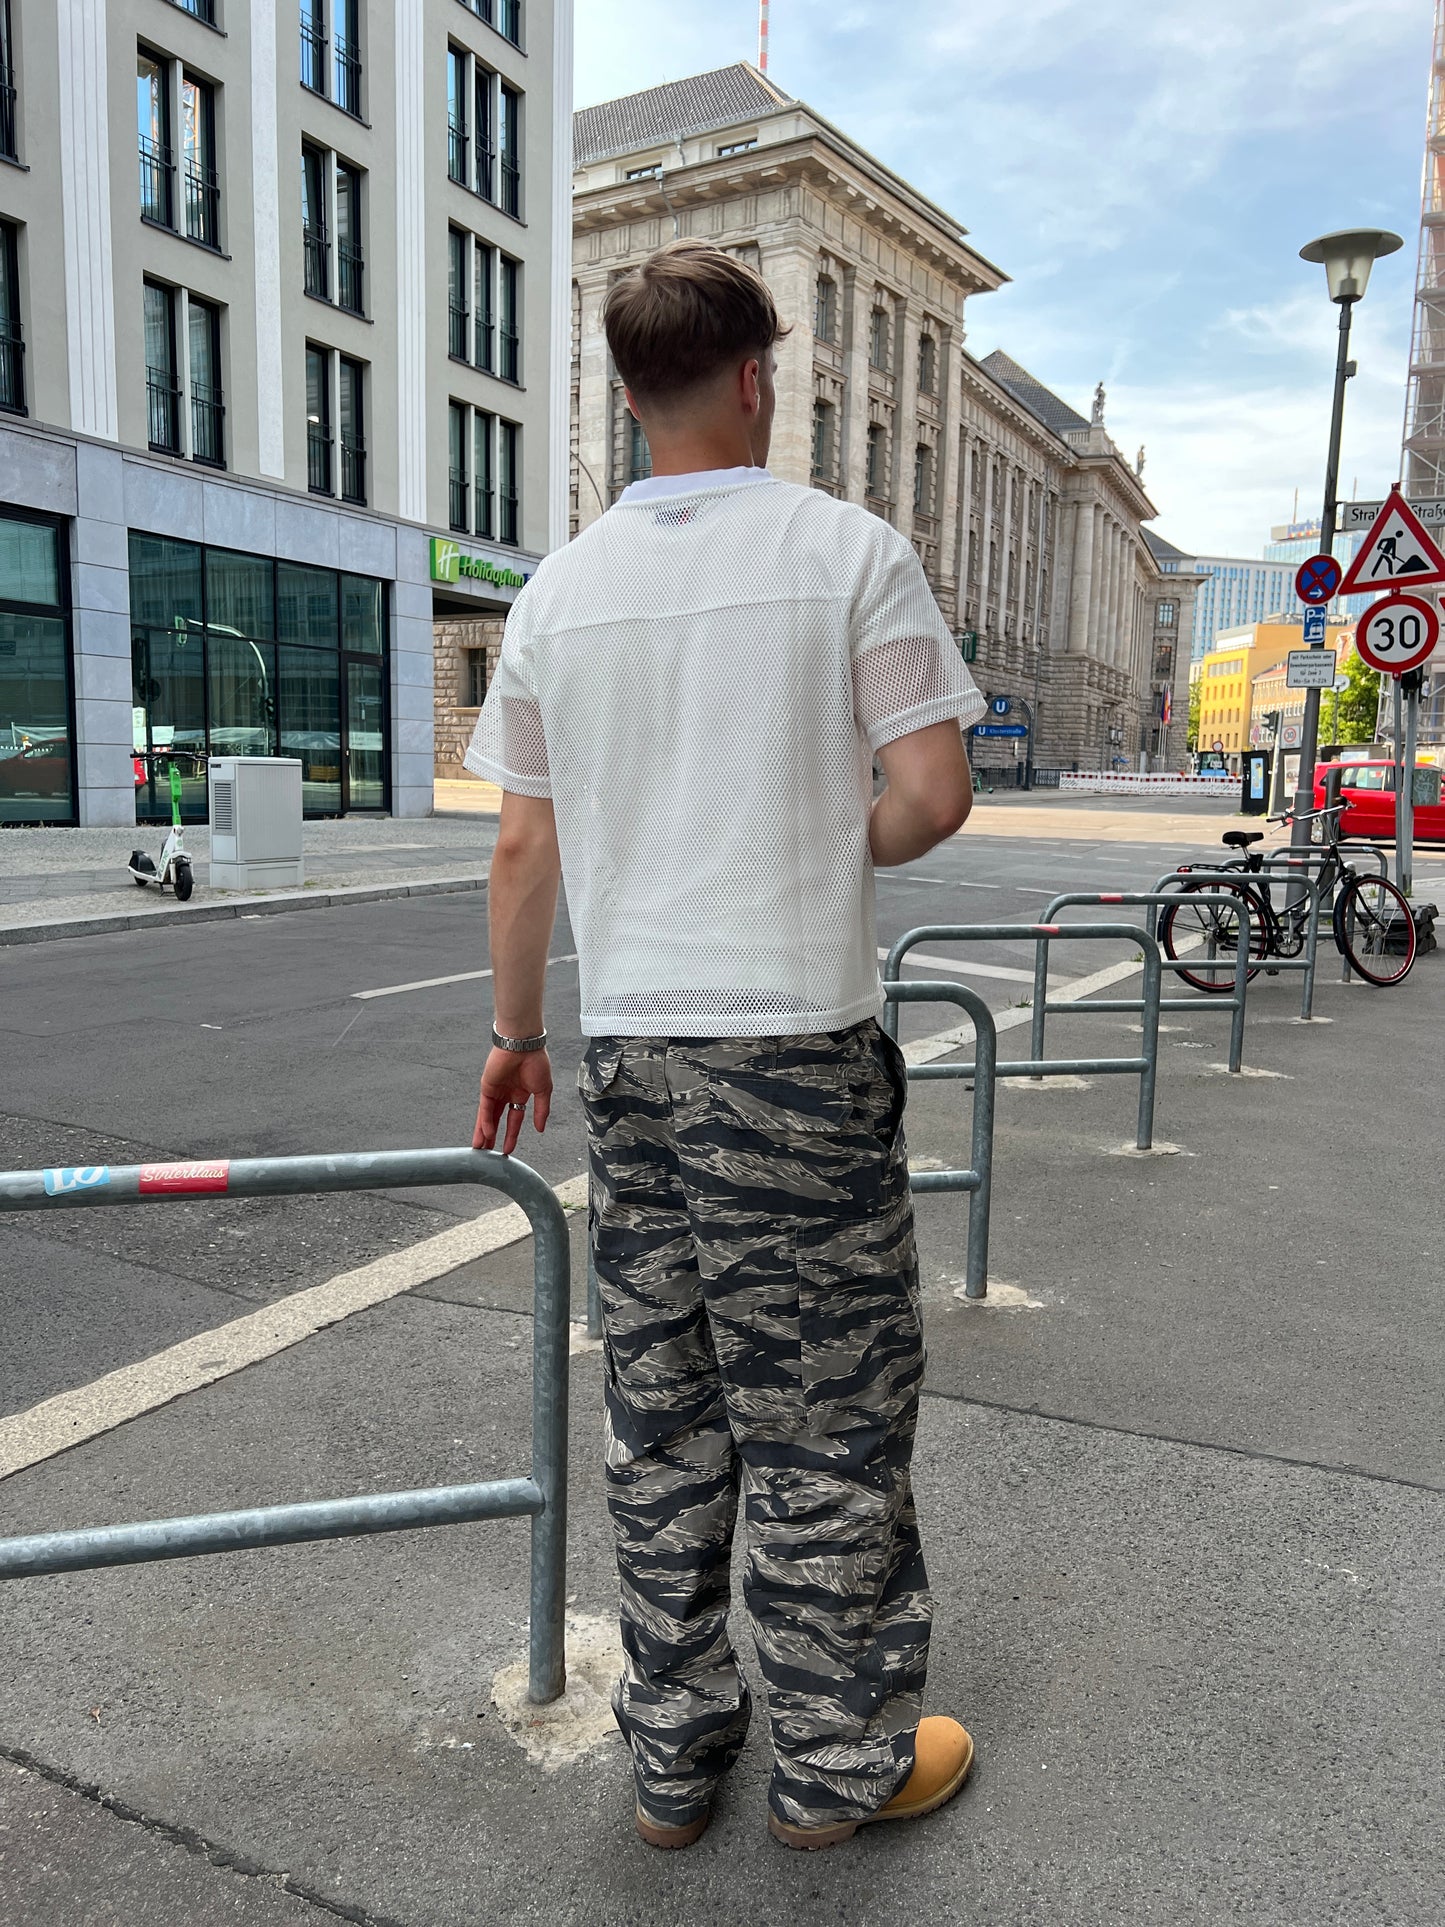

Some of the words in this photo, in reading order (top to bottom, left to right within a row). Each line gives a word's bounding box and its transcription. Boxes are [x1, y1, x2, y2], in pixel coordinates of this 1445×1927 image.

[459, 556, 506, 587] Holiday
[506, 569, 525, 588] Inn
[1306, 609, 1316, 623] P
[1373, 614, 1421, 652] 30
[996, 701, 1006, 713] U
[978, 726, 986, 736] U
